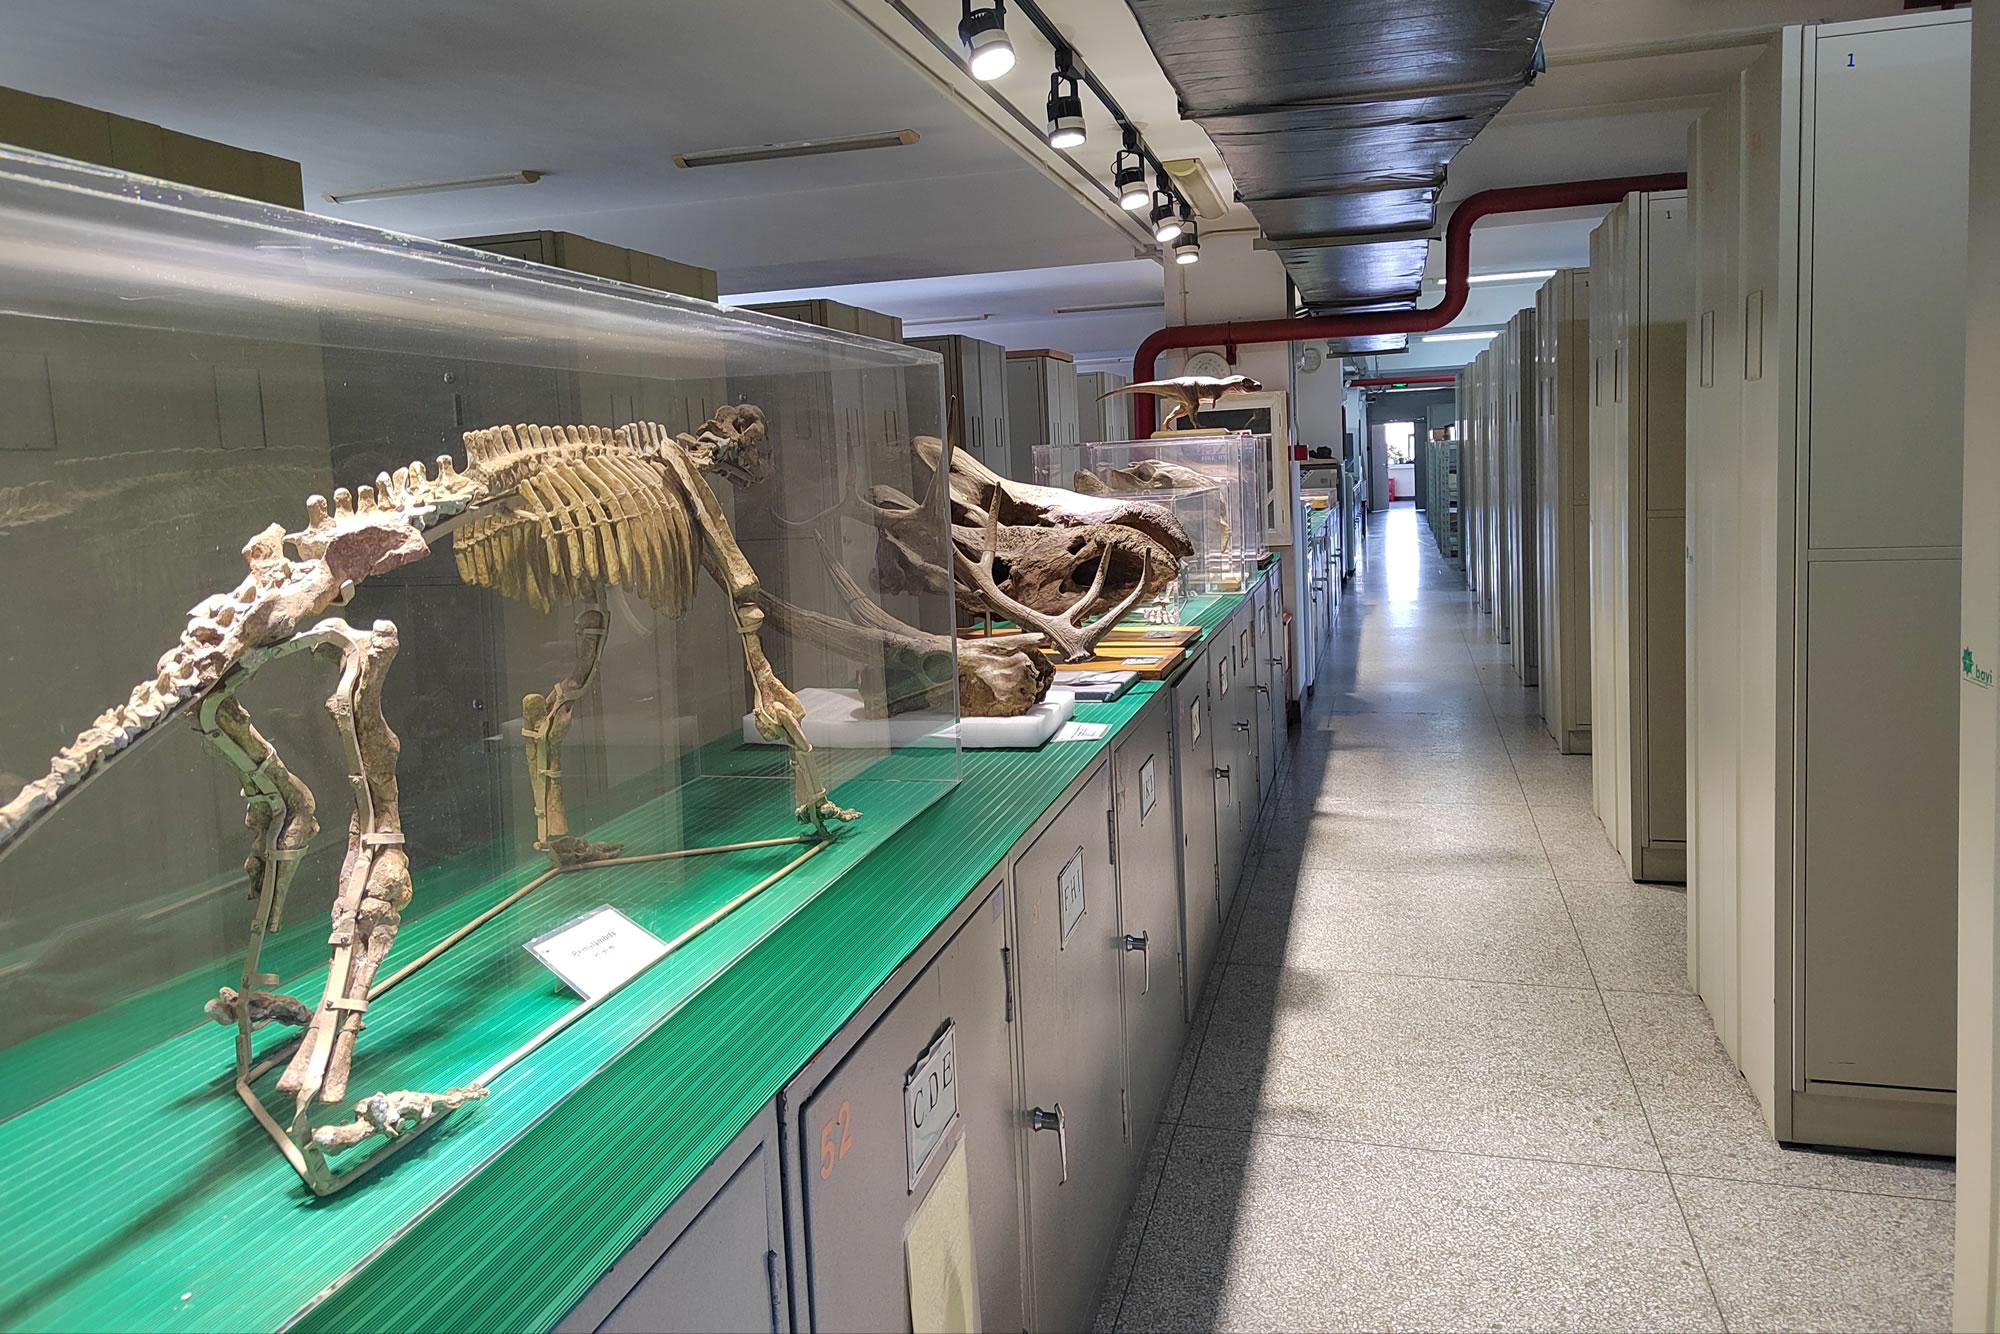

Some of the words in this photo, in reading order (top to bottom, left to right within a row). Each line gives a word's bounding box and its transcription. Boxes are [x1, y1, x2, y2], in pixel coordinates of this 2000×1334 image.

[1846, 52, 1856, 68] 1
[1666, 210, 1672, 220] 1
[1976, 664, 1992, 686] bayi
[819, 1100, 853, 1180] 52
